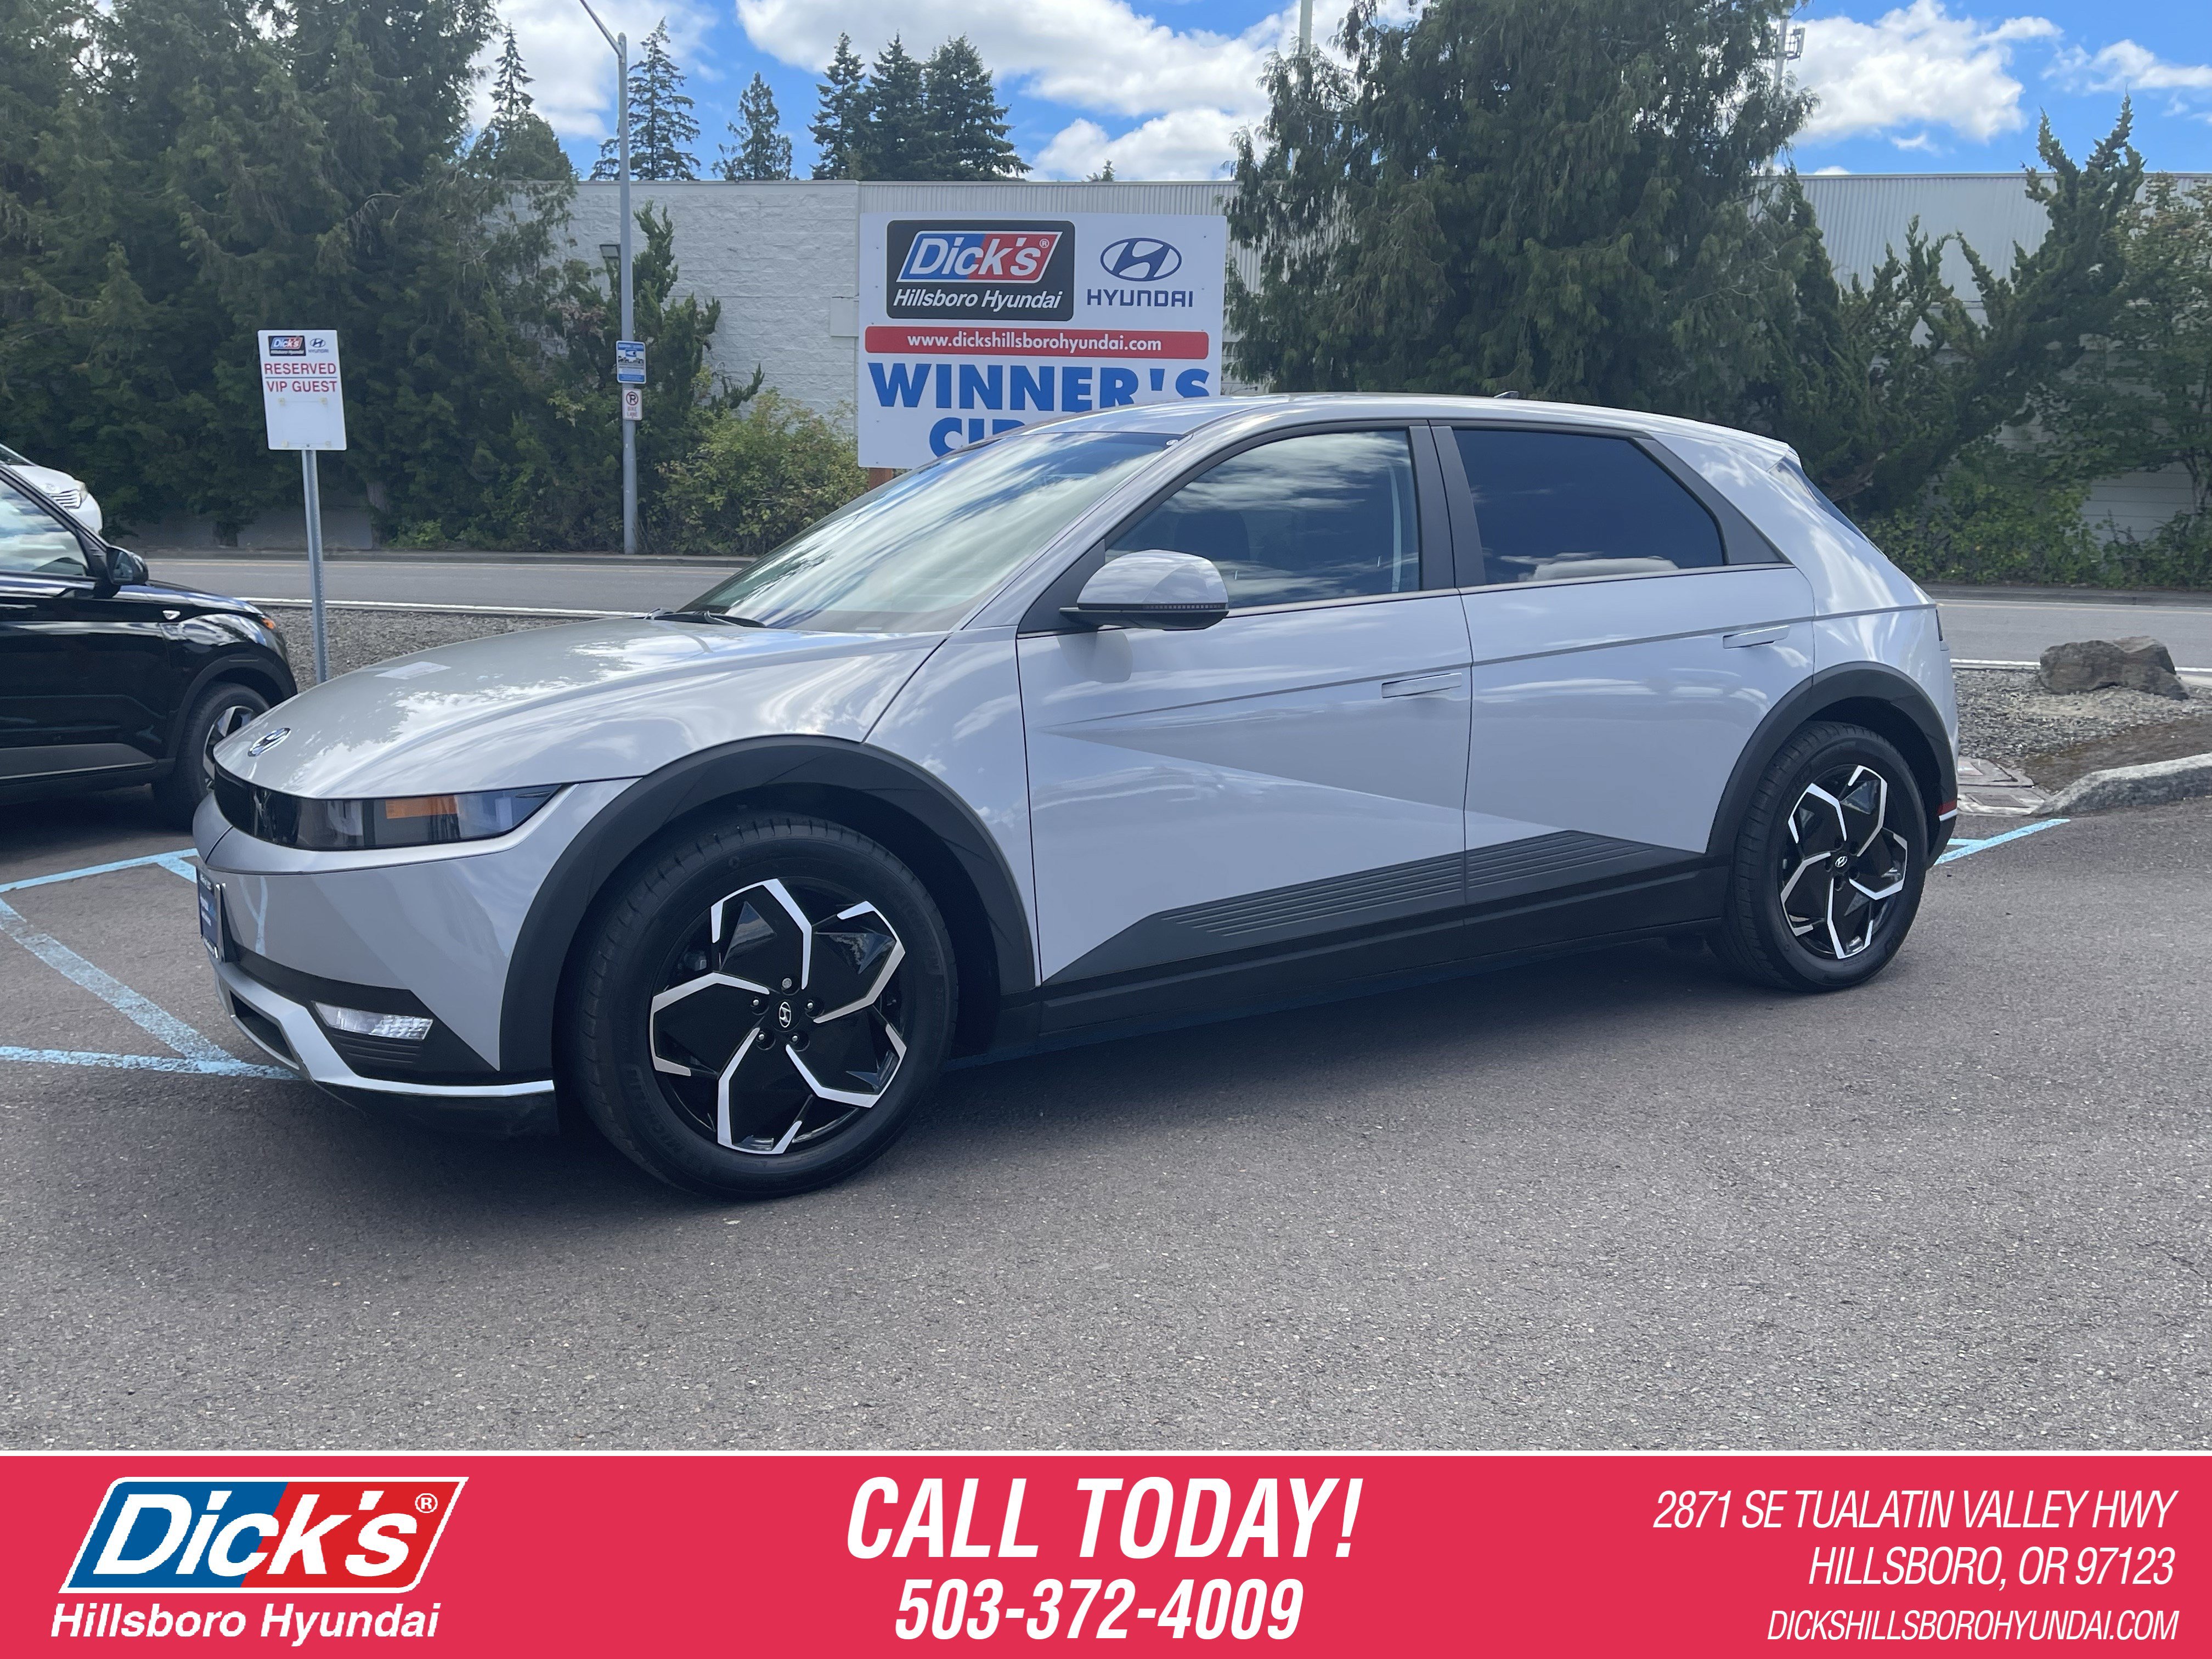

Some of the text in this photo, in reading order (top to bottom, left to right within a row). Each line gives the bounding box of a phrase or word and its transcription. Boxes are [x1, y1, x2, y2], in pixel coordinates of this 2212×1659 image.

[910, 236, 1041, 276] Dick's
[893, 289, 1063, 312] Hillsboro Hyundai
[1087, 289, 1193, 307] HYUNDAI
[907, 331, 1162, 353] www.dickshillsborohyundai.com
[264, 363, 336, 374] RESERVED
[267, 381, 337, 392] VIP GUEST
[867, 362, 1209, 414] WINNER'S
